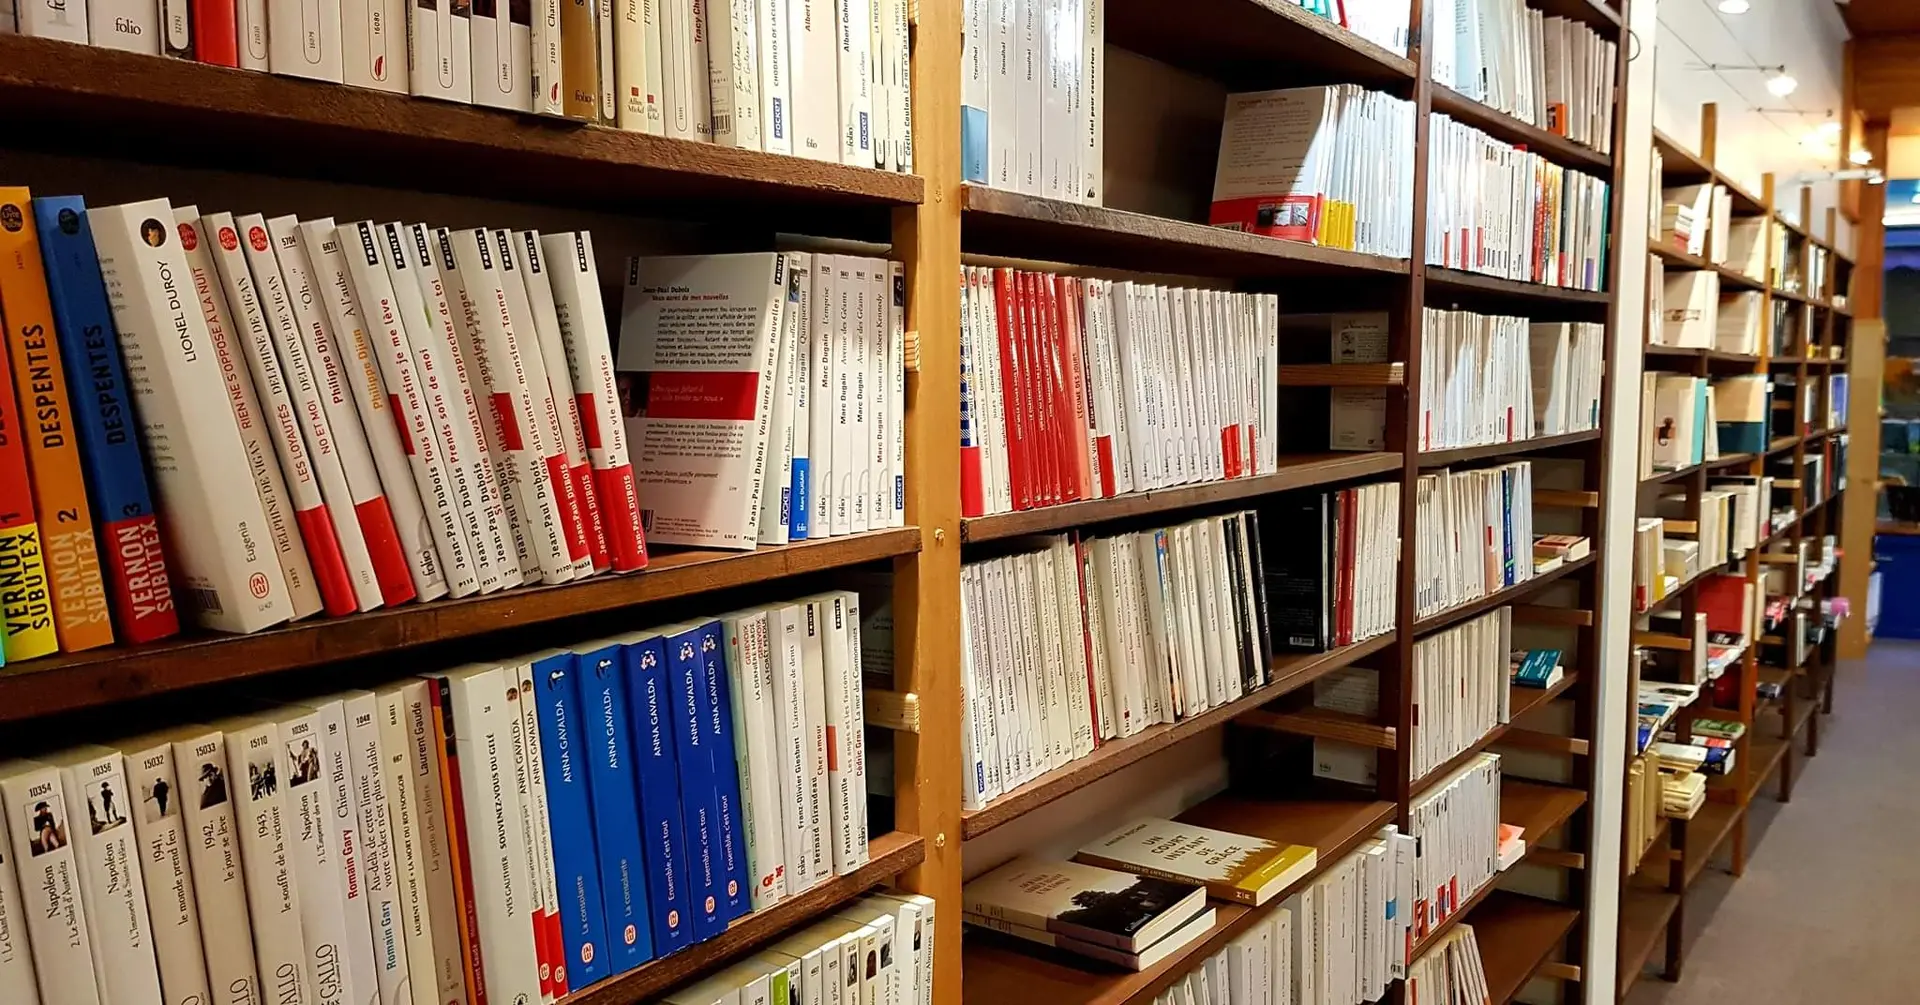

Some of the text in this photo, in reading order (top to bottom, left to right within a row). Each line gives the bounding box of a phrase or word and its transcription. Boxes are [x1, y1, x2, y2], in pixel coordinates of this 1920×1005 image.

[115, 18, 141, 35] folio
[903, 83, 910, 94] Le
[773, 100, 782, 137] POCKET
[859, 112, 867, 148] POCKET
[389, 230, 403, 264] POINTS
[774, 256, 783, 284] POINTS
[157, 261, 196, 361] LIONEL DUROY
[268, 276, 310, 390] DELPHINE DE VIGAN
[495, 289, 509, 327] Tanner
[238, 277, 281, 394] DELPHINE DE VIGAN
[506, 332, 524, 383] monsieur
[23, 325, 62, 447] DESPENTES
[84, 326, 124, 443] DESPENTES
[313, 322, 342, 403] Philippe Djian
[350, 328, 383, 411] Philippe Djian
[601, 355, 613, 403] française
[1070, 351, 1079, 373] JOURS
[544, 397, 565, 453] succession
[568, 398, 584, 452] succession
[749, 479, 759, 526] Jean-Paul
[754, 442, 763, 474] Dubois
[764, 370, 771, 380] de
[770, 298, 779, 343] nouvelles
[277, 404, 309, 482] LES LOYAUTÉS
[534, 453, 550, 483] Vous
[58, 508, 78, 522] 2
[123, 502, 142, 518] 3
[248, 440, 290, 552] DELPHINE DE VIGAN
[429, 467, 464, 568] Jean-Paul Dubois
[454, 467, 488, 567] Jean-Paul Dubois
[473, 463, 505, 561] Jean-Paul Dubois
[496, 462, 527, 559] Jean-Paul Dubois
[530, 460, 559, 557] Jean-Paul Dubois
[560, 464, 585, 543] Jean-Paul DUBOIS
[582, 474, 606, 553] Jean-Paul DUBOIS
[140, 521, 172, 611] SUBUTEX
[238, 521, 255, 562] Eugenia
[420, 550, 435, 575] folio
[0, 536, 28, 634] VERNON
[19, 533, 49, 628] SUBUTEX
[50, 533, 85, 627] VERNON
[74, 529, 107, 621] SUBUTEX
[118, 526, 153, 617] VERNON
[749, 623, 758, 649] HARDE
[850, 626, 858, 678] Cosmonautes
[789, 669, 796, 678] de
[854, 711, 860, 721] La
[29, 783, 51, 798] 10354
[403, 826, 410, 837] DU
[1142, 836, 1163, 846] UN
[1151, 835, 1189, 854] COURT
[1164, 836, 1210, 861] INSTANT
[1196, 848, 1215, 856] DE
[1205, 846, 1242, 866] GRÂCE
[104, 843, 118, 893] Napoléon
[270, 806, 290, 912] le souffle de la victoire
[407, 861, 414, 870] LA
[665, 858, 674, 900] Ensemble,
[43, 866, 60, 918] Napoléon
[577, 876, 588, 934] La consolante
[412, 905, 421, 936] LAURENT
[315, 944, 336, 998] GALLO
